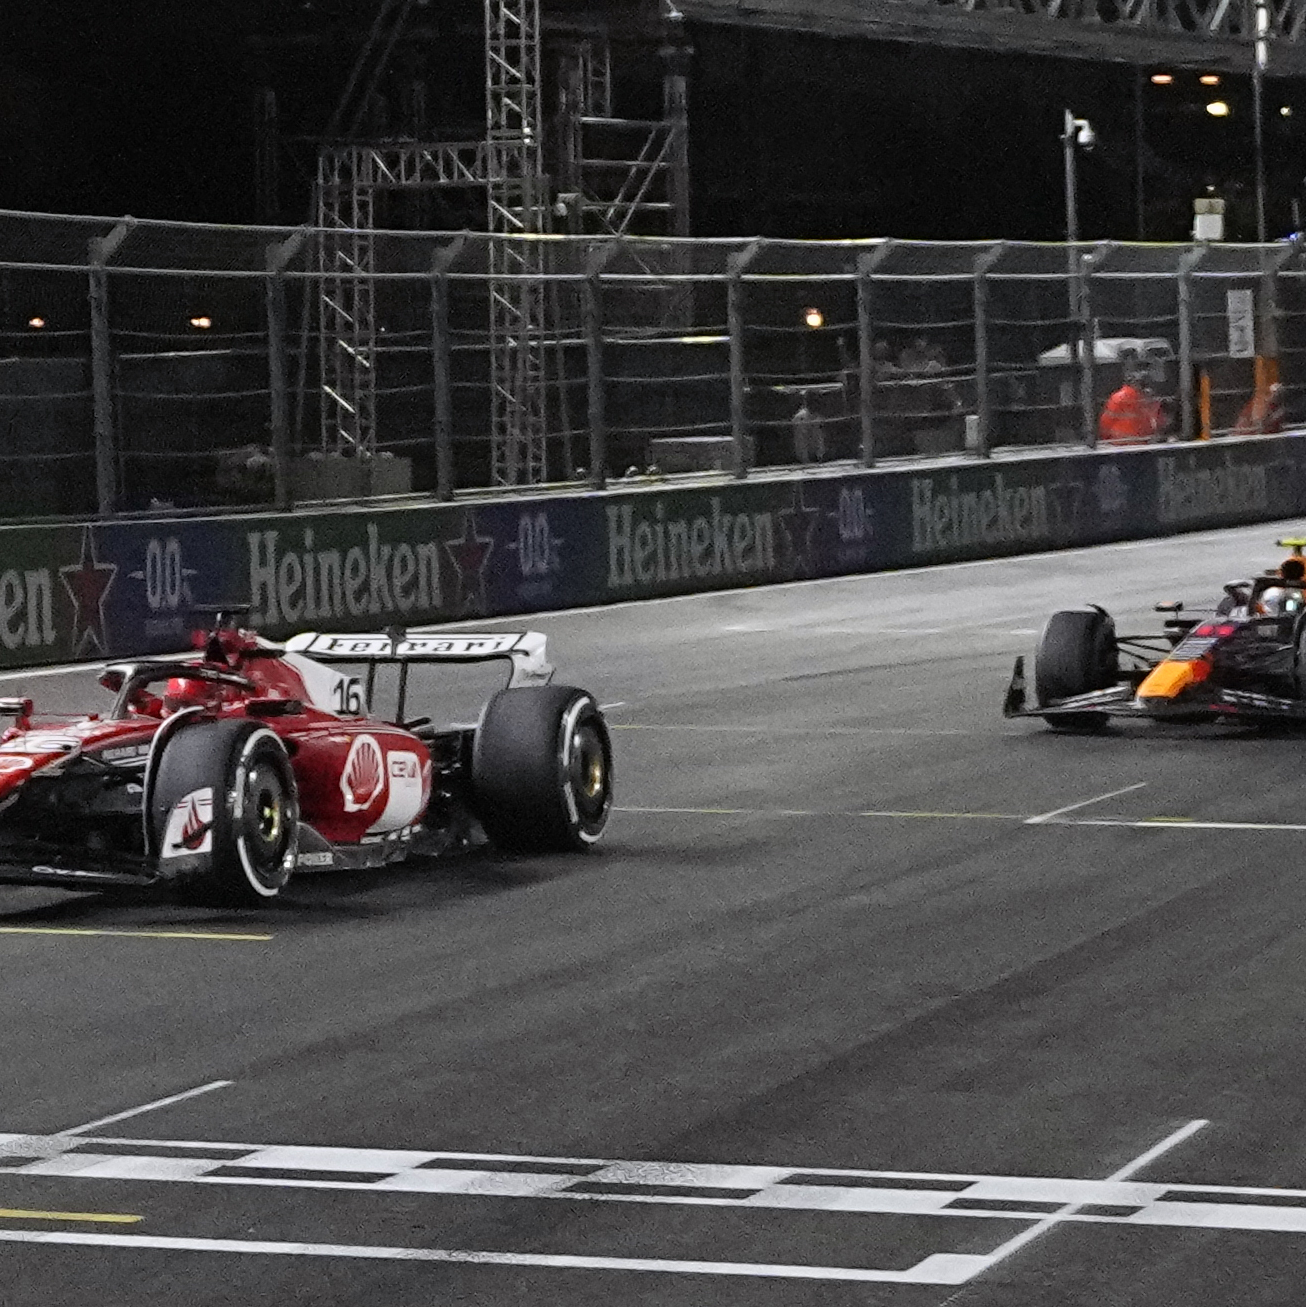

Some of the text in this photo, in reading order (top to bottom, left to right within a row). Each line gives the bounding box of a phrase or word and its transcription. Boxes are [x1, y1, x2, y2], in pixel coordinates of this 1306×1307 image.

[606, 497, 775, 589] Heineken
[911, 474, 1049, 553] Heineken
[247, 521, 441, 627] Heineken
[325, 636, 508, 653] Ferrari
[333, 677, 362, 716] 16
